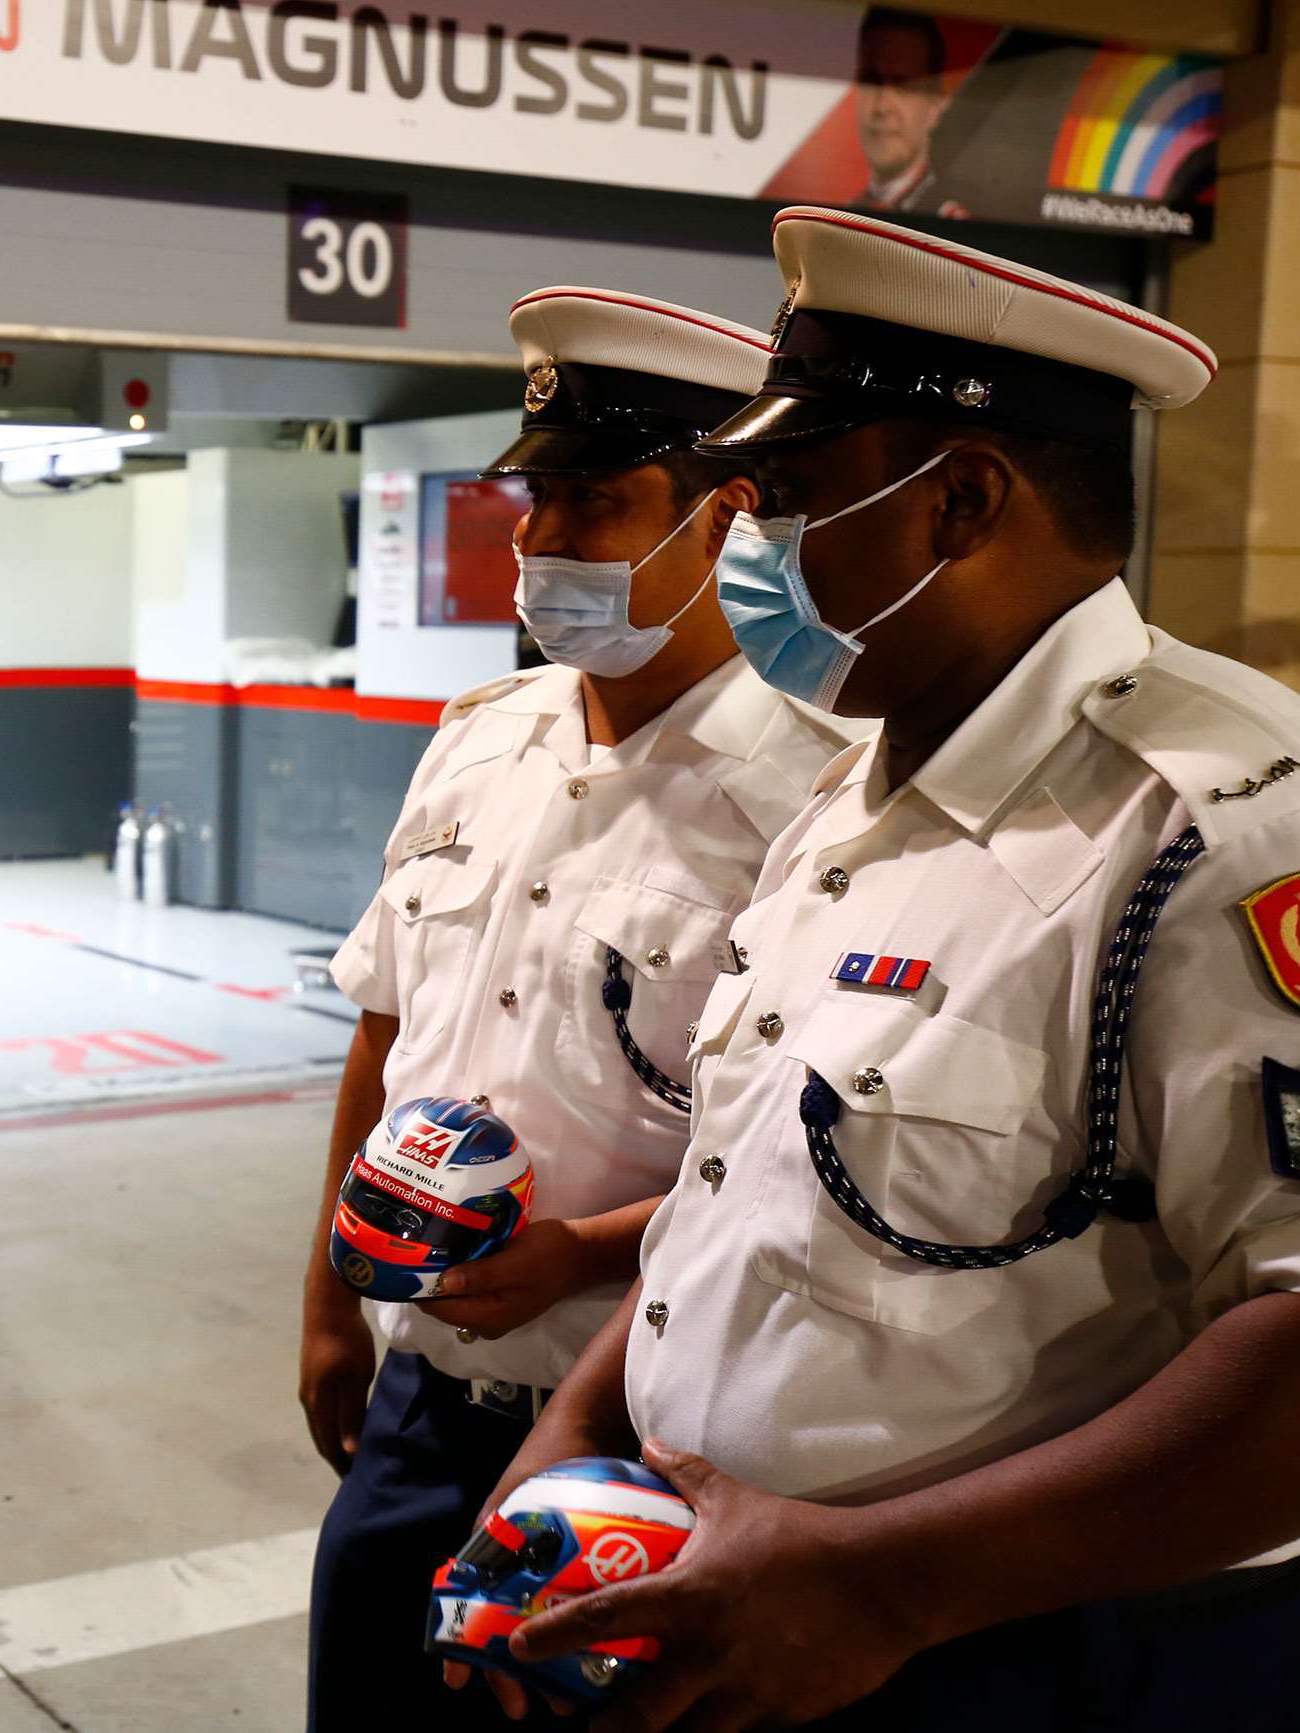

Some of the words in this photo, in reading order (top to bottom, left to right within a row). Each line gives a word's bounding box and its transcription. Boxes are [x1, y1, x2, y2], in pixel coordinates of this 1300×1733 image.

[63, 0, 769, 141] MAGNUSSEN
[298, 217, 392, 297] 30
[376, 1155, 413, 1178] RICHARD
[414, 1172, 445, 1192] MILLE
[396, 1145, 440, 1165] HAAS
[356, 1162, 373, 1180] Haas
[371, 1172, 433, 1209] Automation
[434, 1202, 455, 1219] Inc.
